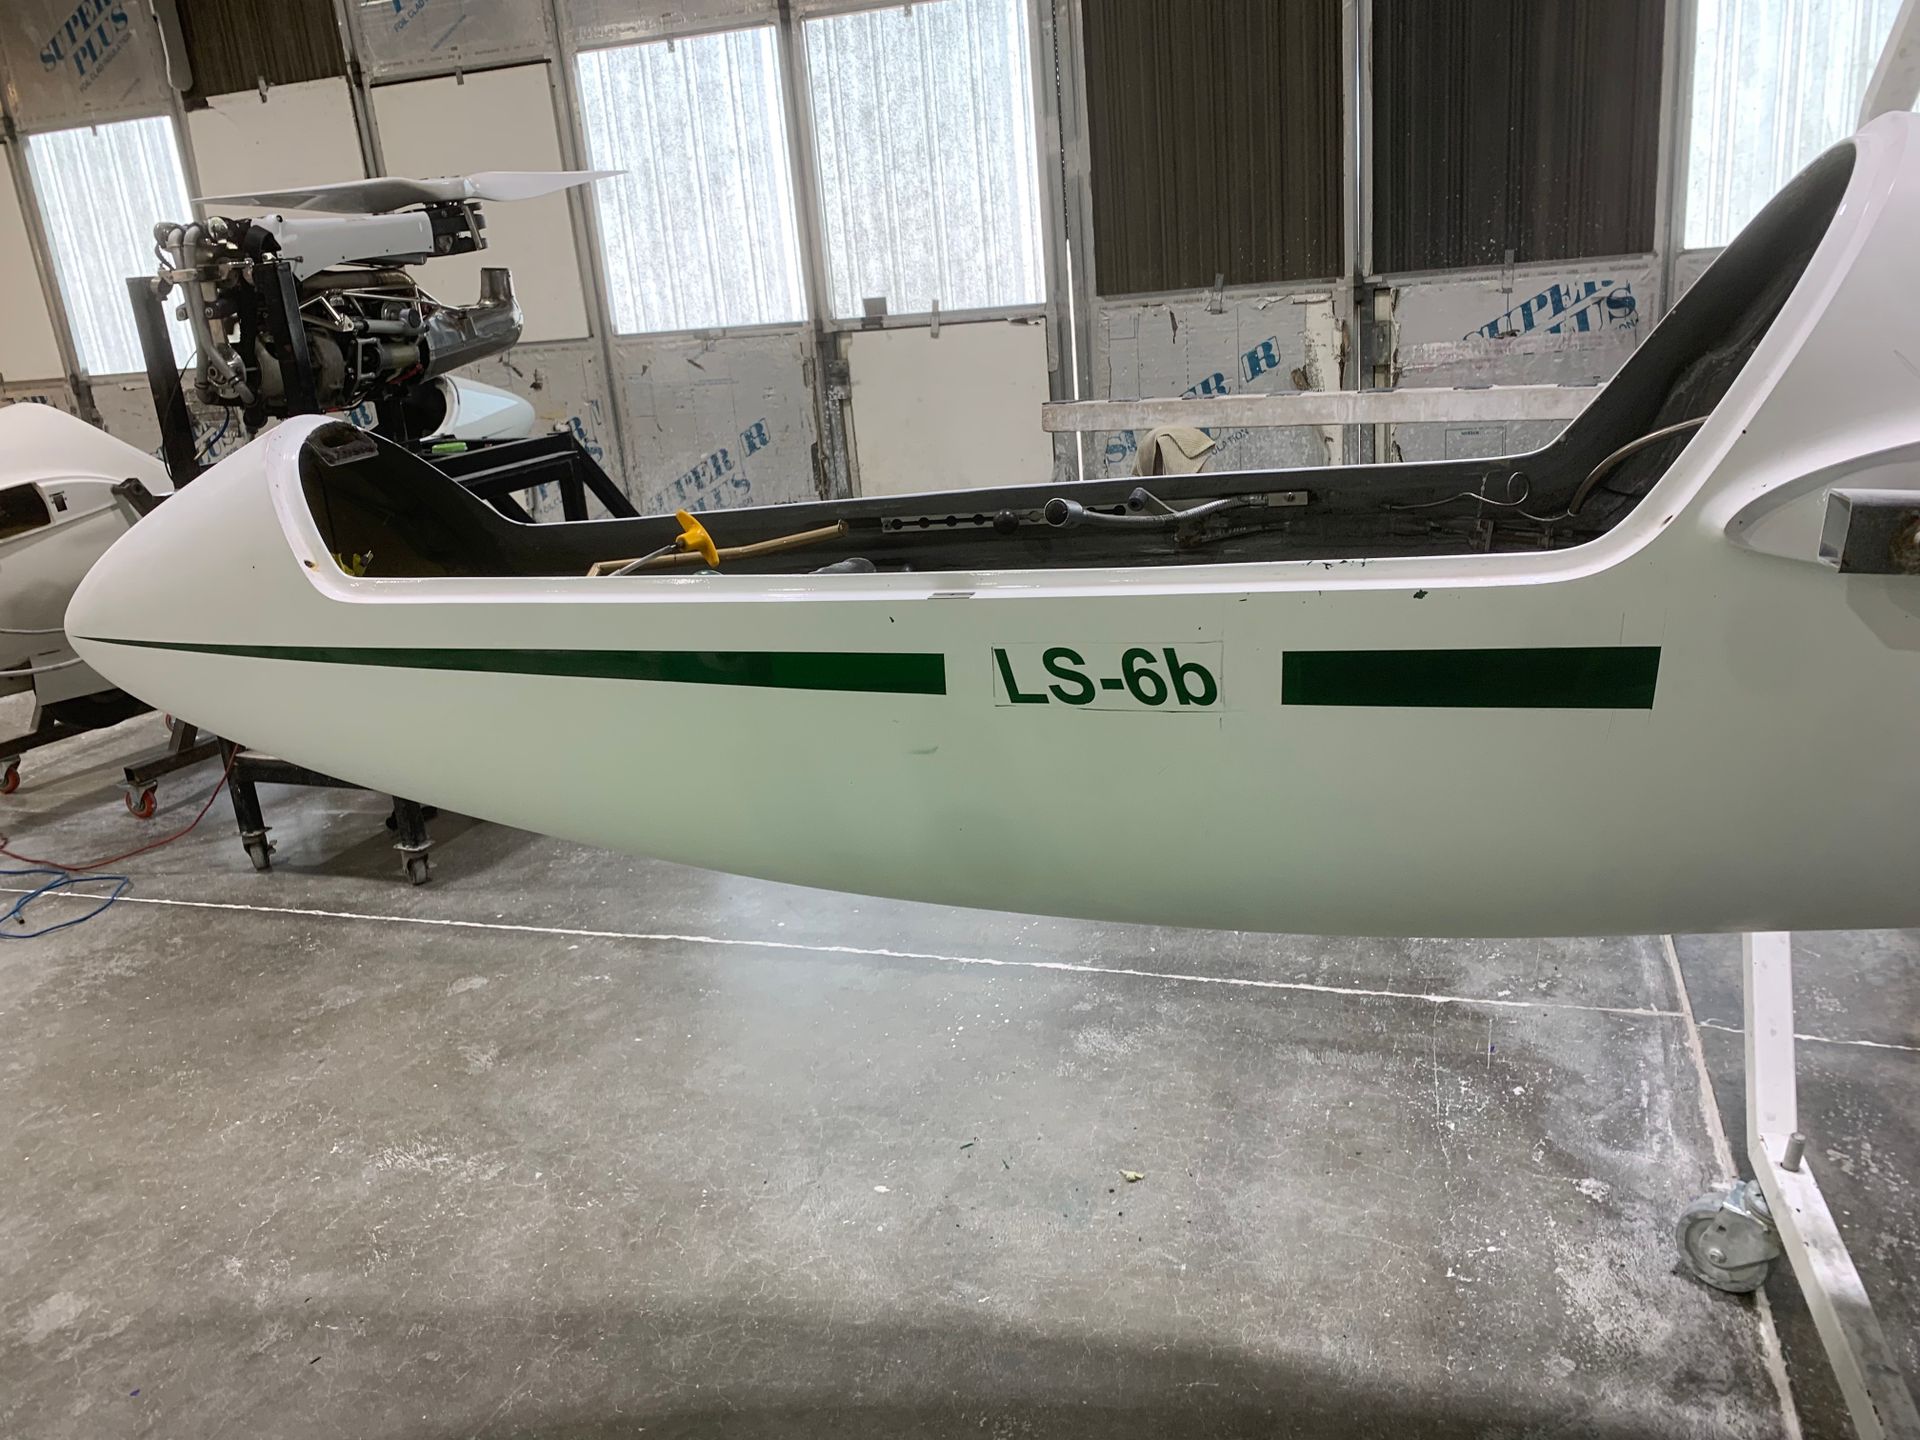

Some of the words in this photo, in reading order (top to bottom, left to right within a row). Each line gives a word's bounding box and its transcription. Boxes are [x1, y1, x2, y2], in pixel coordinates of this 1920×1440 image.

[73, 2, 128, 76] PLUS
[1211, 428, 1250, 456] ULATION
[650, 448, 735, 513] UPER
[994, 647, 1218, 706] LS-6b
